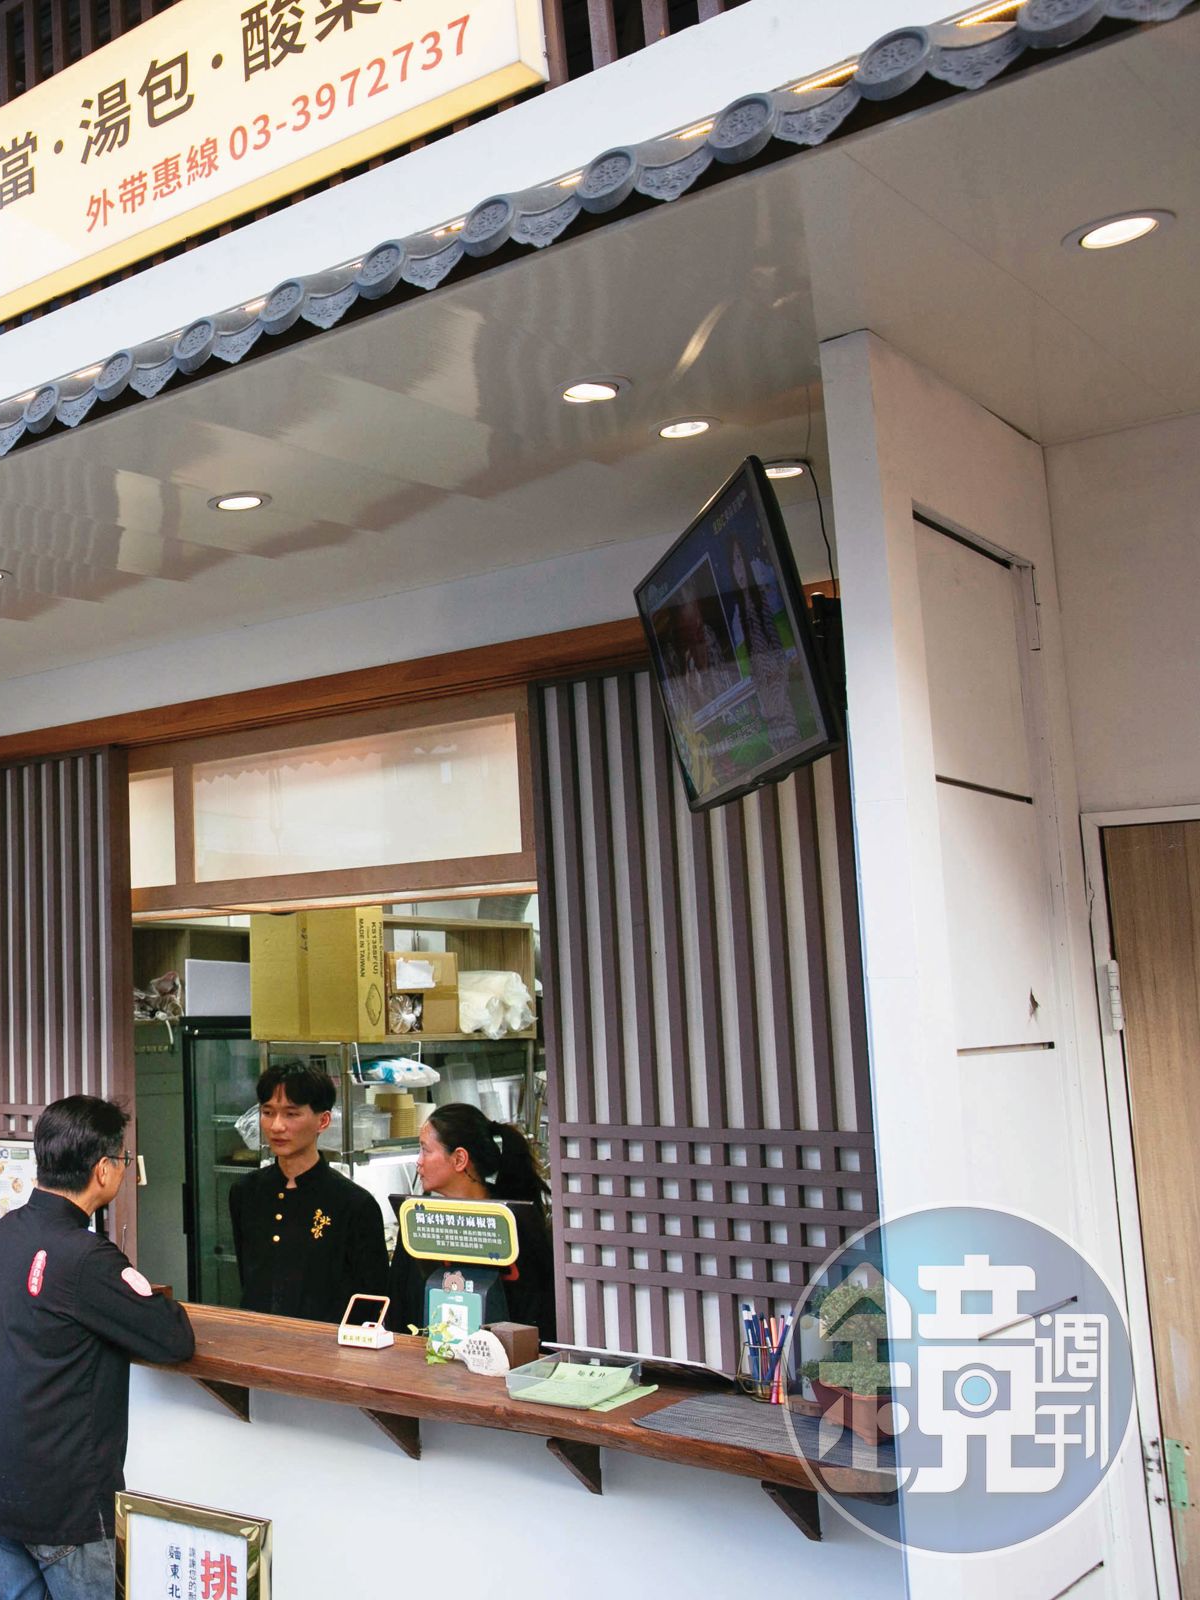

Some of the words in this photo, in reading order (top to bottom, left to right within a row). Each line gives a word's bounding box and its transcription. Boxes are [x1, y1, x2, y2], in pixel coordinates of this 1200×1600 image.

[229, 14, 470, 160] 03-3972737
[360, 940, 365, 949] IN
[200, 1550, 239, 1600] 排
